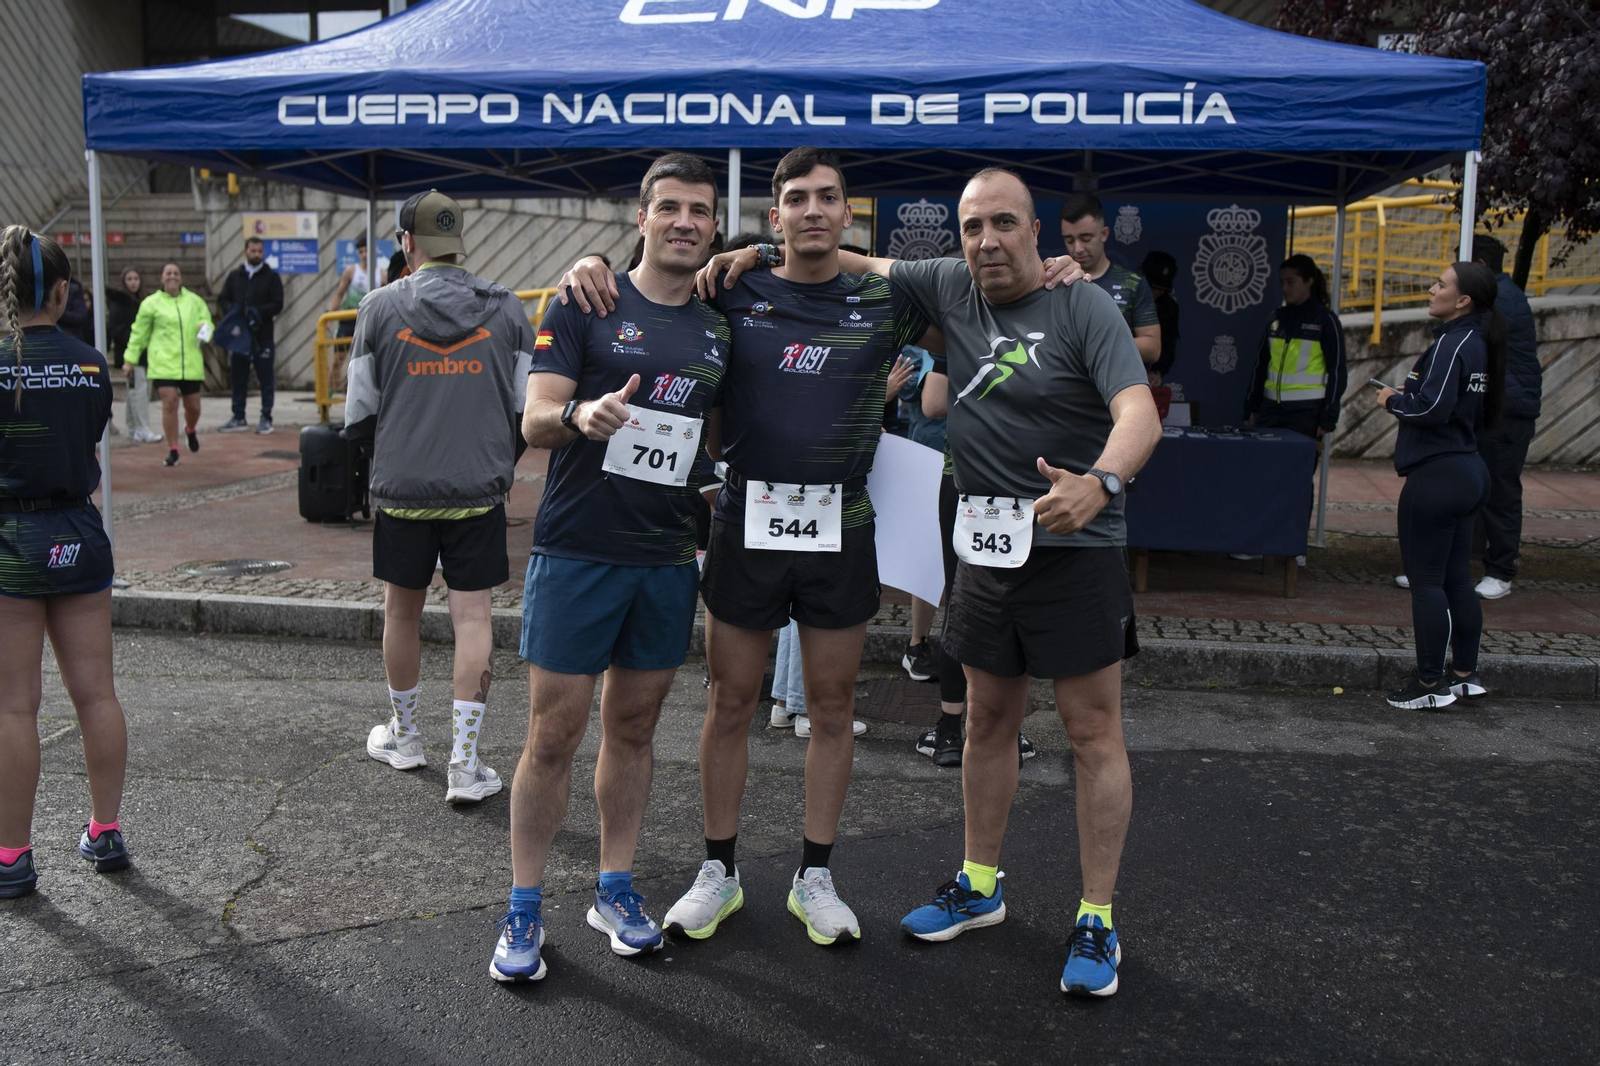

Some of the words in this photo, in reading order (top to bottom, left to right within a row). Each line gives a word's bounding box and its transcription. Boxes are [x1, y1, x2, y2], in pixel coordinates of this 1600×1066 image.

[278, 93, 519, 126] CUERPO
[542, 92, 847, 126] NACIONAL
[871, 93, 959, 125] DE
[984, 82, 1237, 125] POLICÍA
[839, 319, 873, 328] Santander
[407, 357, 483, 375] umbro
[795, 346, 831, 371] 091
[664, 376, 698, 404] 091
[632, 443, 678, 472] 701
[768, 518, 818, 538] 544
[58, 543, 81, 565] 091
[971, 532, 1012, 554] 543
